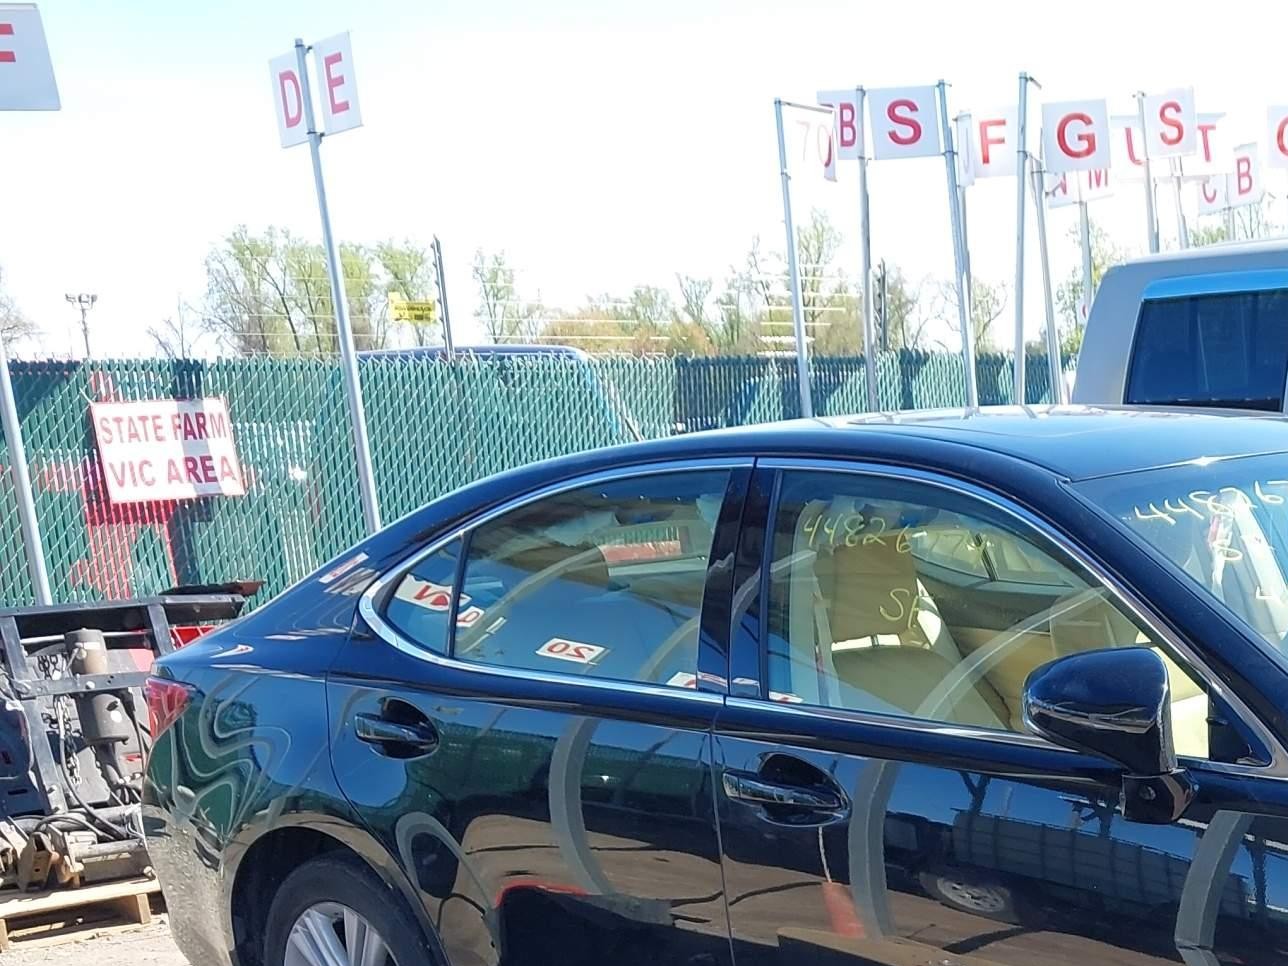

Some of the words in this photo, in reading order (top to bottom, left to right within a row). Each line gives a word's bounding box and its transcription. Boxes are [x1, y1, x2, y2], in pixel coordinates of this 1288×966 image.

[279, 69, 303, 128] D
[324, 52, 349, 114] E
[839, 102, 857, 147] B
[887, 98, 922, 146] S
[978, 118, 1007, 166] F
[1056, 112, 1097, 159] G
[1159, 101, 1184, 146] S
[1197, 124, 1217, 163] T
[1236, 156, 1253, 196] B
[100, 415, 167, 445] STATE
[170, 411, 228, 441] FARM
[108, 458, 156, 488] VIC
[167, 454, 237, 485] AREA
